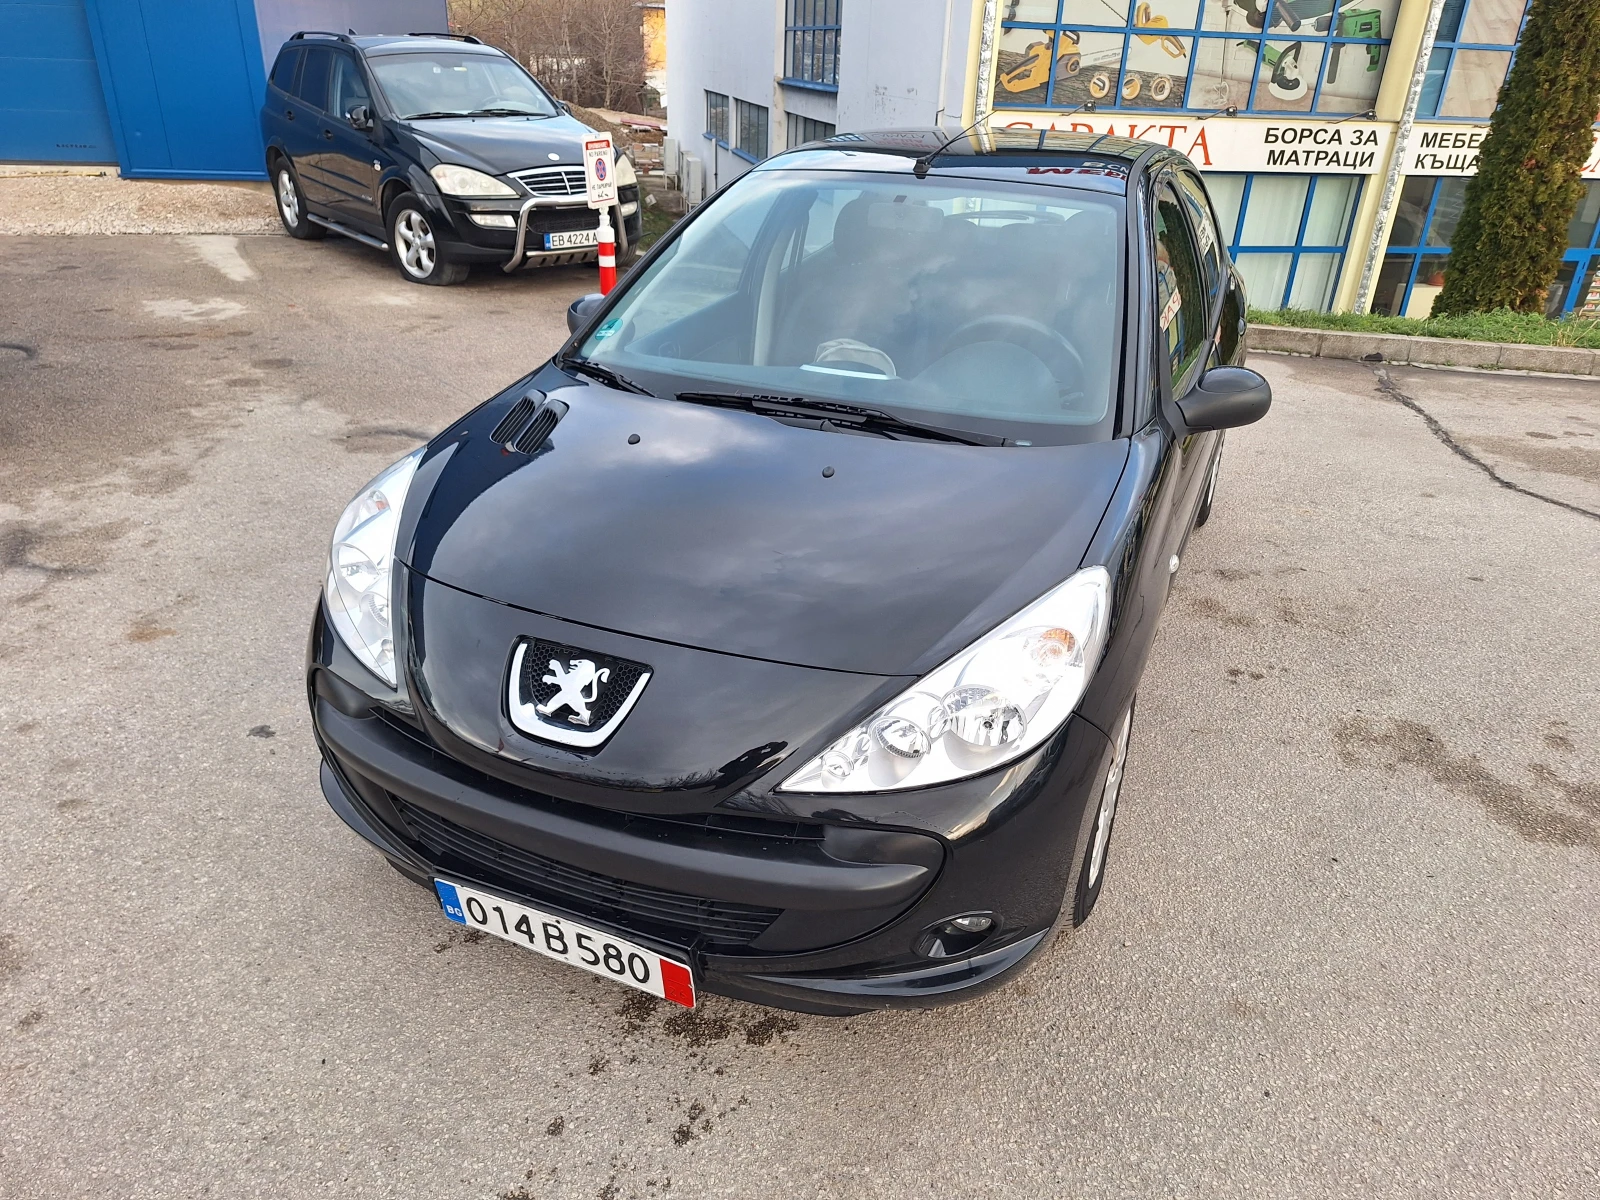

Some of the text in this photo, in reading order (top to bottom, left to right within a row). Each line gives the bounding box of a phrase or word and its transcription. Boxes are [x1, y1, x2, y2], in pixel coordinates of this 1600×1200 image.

[1264, 127, 1378, 146] БОРСА ЗА
[1266, 149, 1375, 170] МАТРАЦИ
[1414, 153, 1480, 173] КЪЩА
[551, 234, 565, 247] EB
[567, 232, 590, 245] 4224
[446, 904, 463, 917] BG
